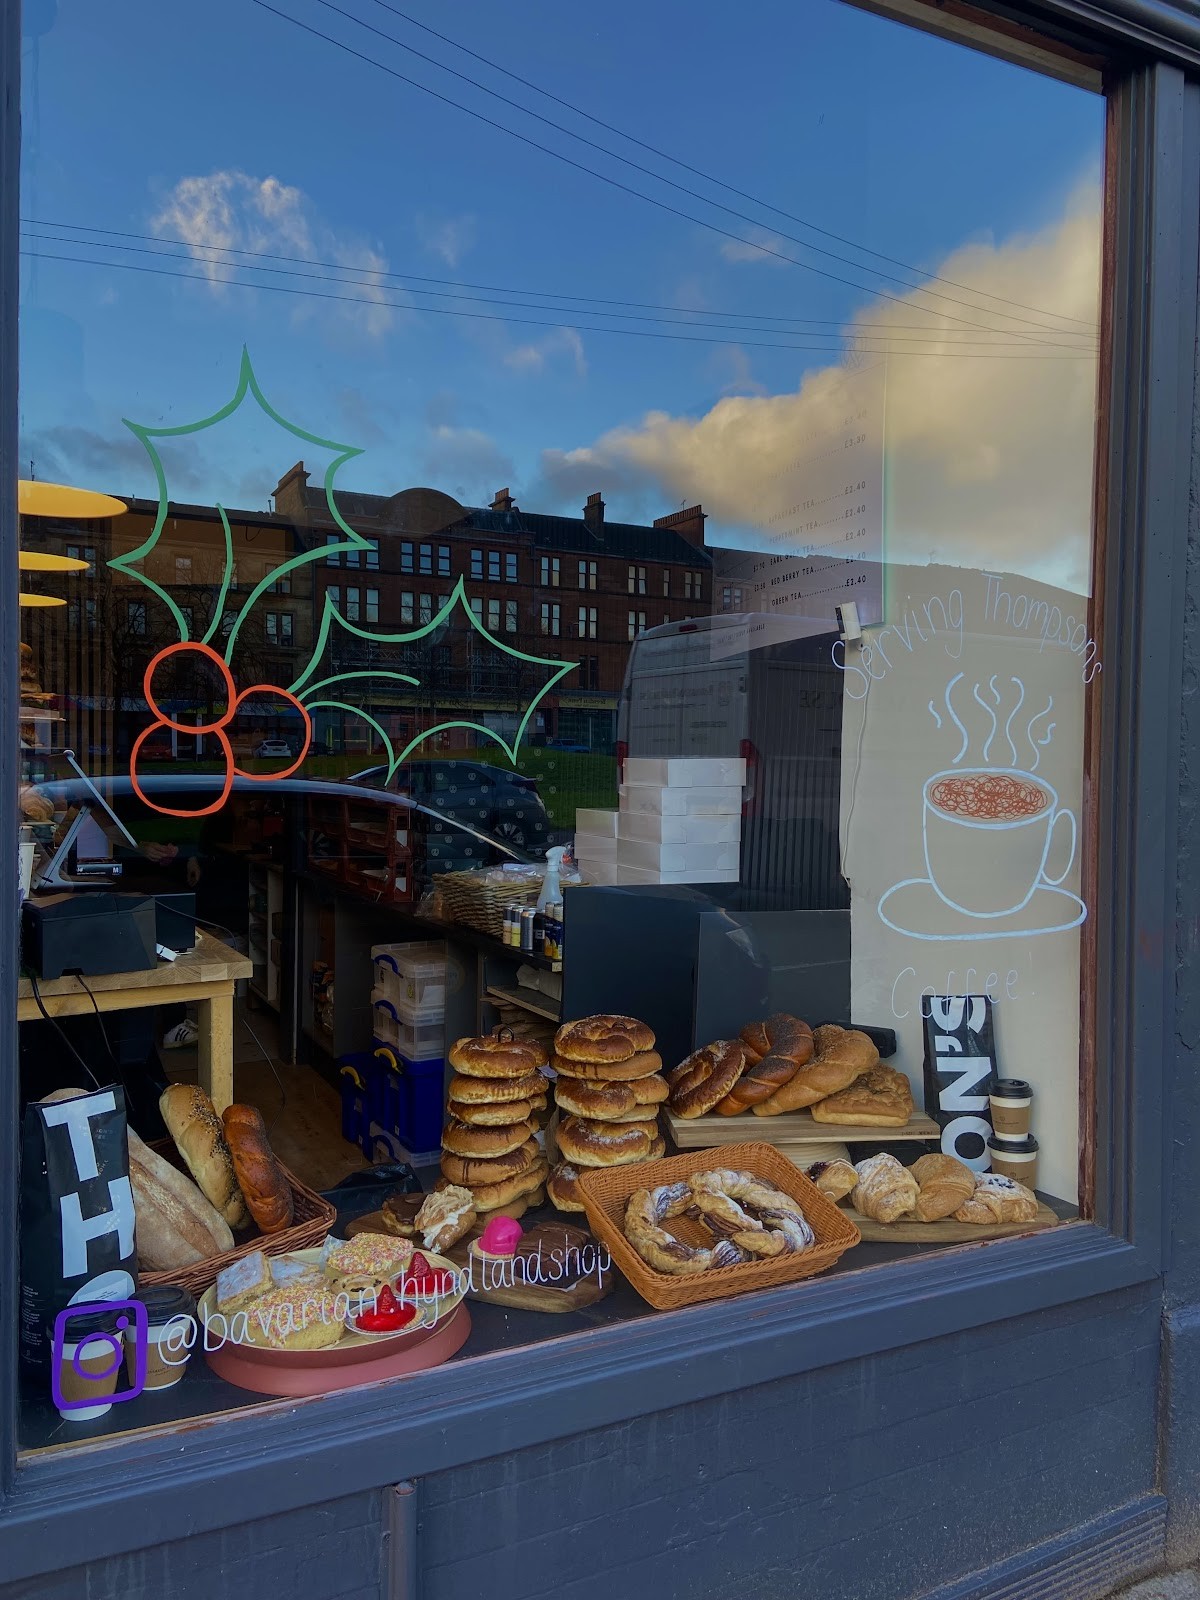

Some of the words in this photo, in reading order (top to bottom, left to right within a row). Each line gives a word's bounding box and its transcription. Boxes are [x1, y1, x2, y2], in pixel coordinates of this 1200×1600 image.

[803, 499, 815, 510] TEA
[806, 520, 818, 530] TEA
[845, 528, 866, 542] £2.40
[782, 570, 800, 582] BERRY
[802, 566, 814, 576] TEA
[771, 595, 789, 607] GREEN
[790, 591, 802, 601] TEA
[831, 589, 963, 699] Serving
[981, 573, 1102, 684] Thompsons
